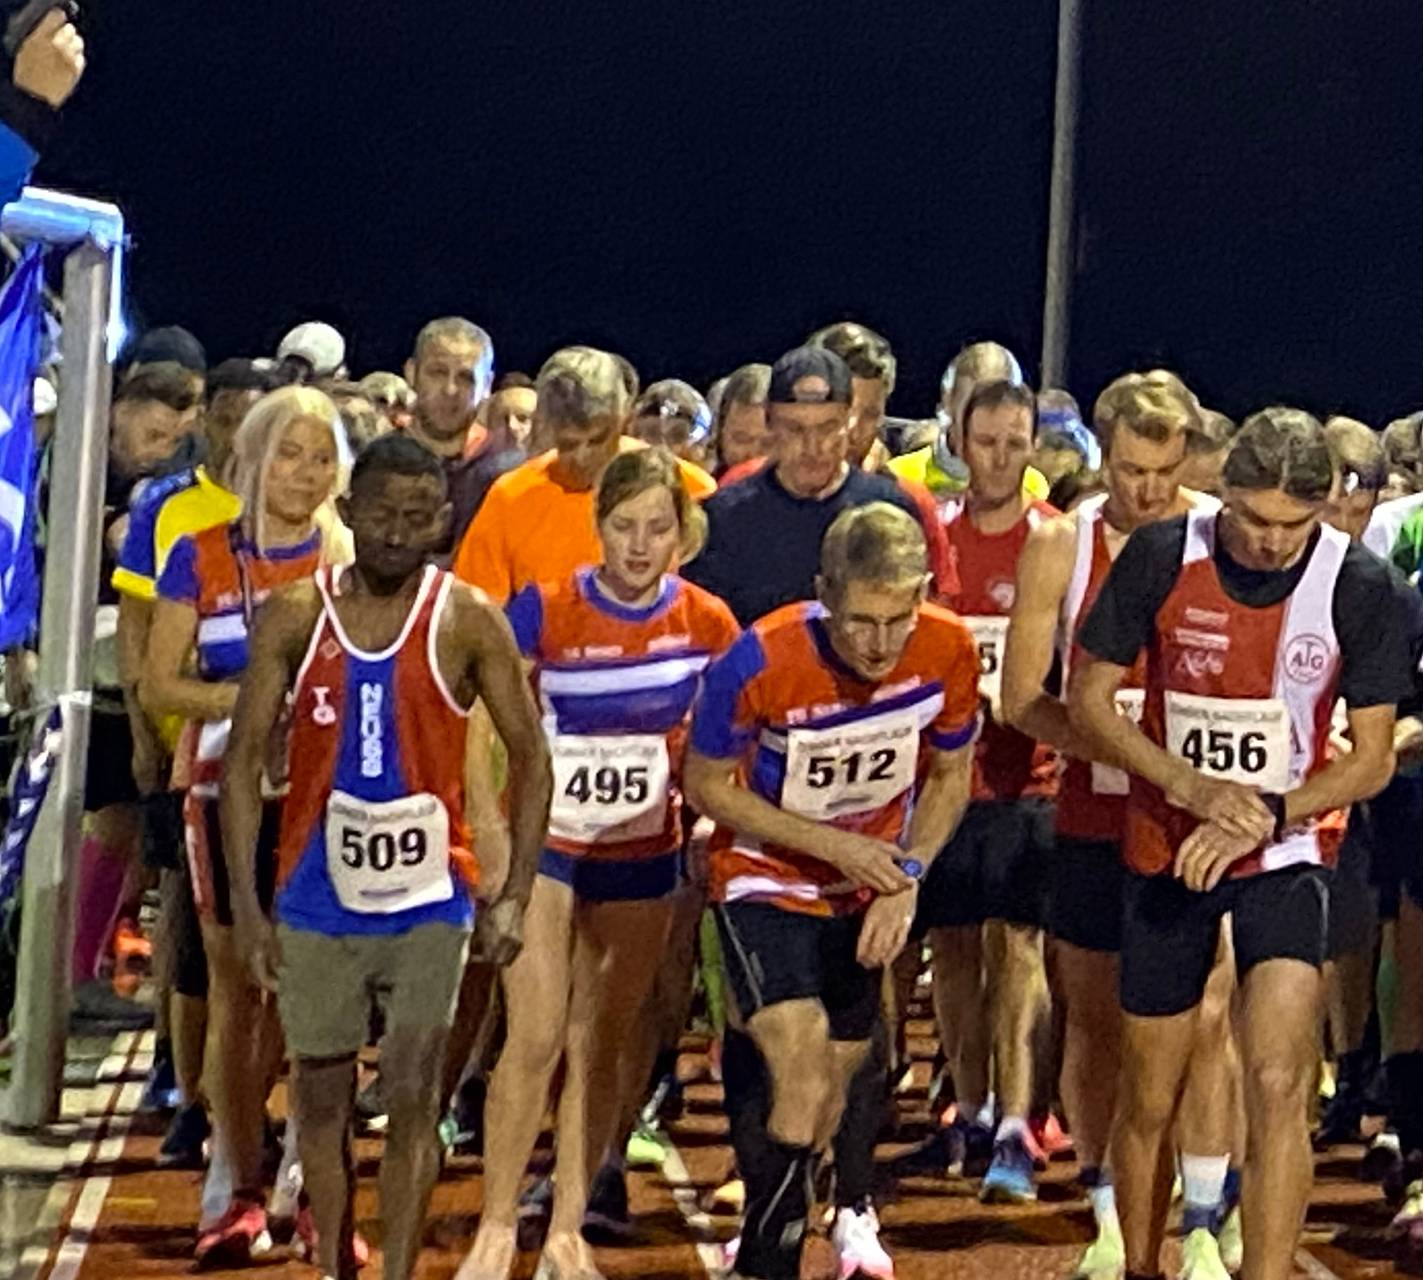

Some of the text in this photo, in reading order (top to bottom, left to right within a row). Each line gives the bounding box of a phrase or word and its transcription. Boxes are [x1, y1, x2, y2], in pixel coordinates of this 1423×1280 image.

[806, 748, 897, 789] 512
[1181, 728, 1268, 773] 456
[564, 765, 650, 805] 495
[340, 826, 427, 872] 509
